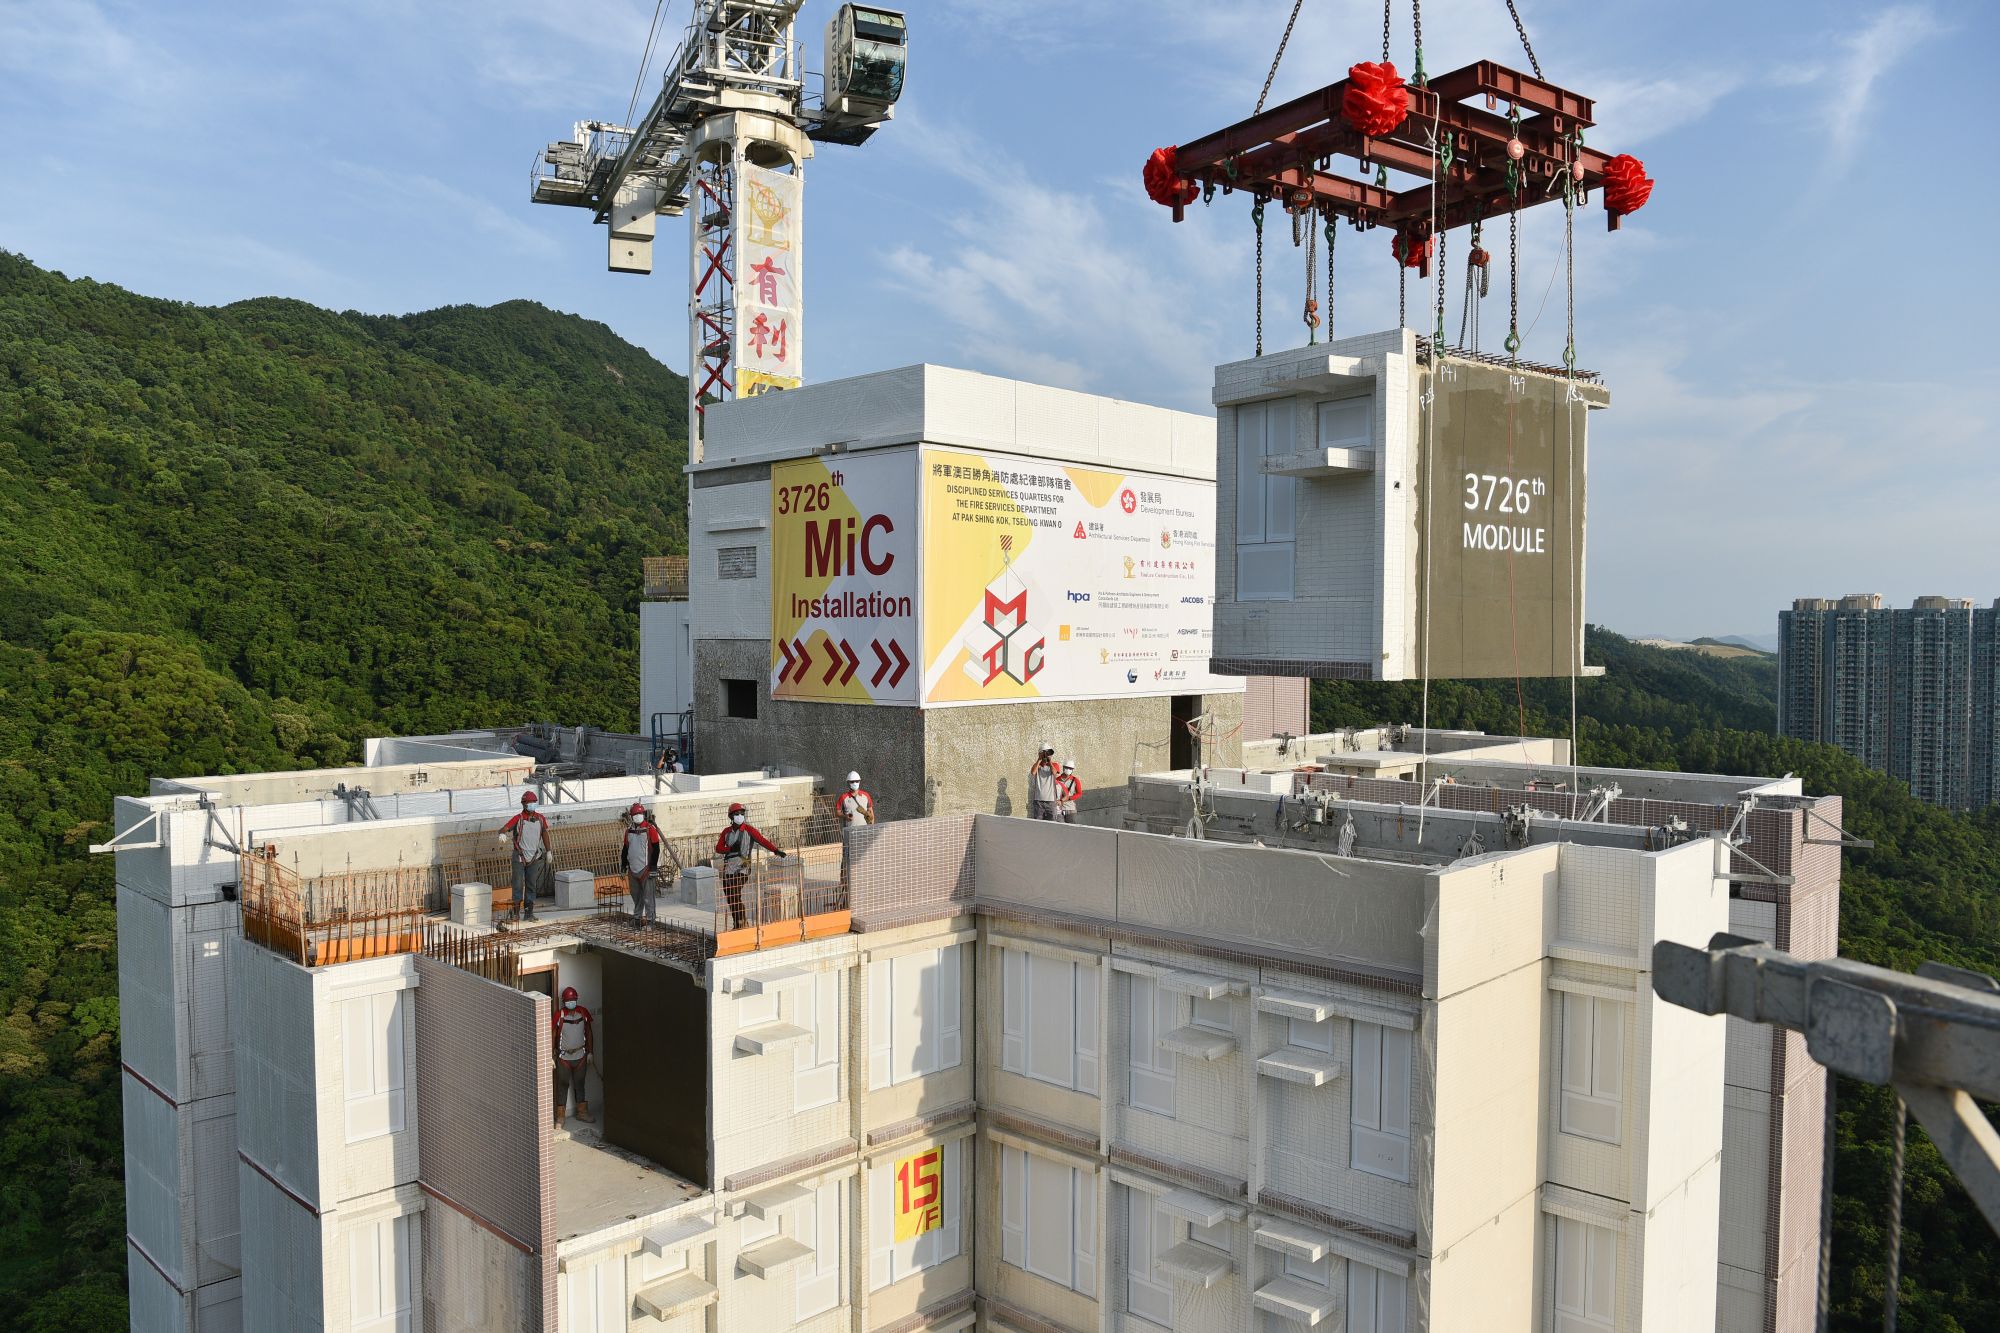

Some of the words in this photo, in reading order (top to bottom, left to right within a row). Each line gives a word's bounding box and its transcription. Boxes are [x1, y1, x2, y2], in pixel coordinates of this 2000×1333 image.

[748, 256, 787, 363] 有利
[932, 463, 1072, 491] 將軍澳百勝角消防處紀律部隊宿舍
[946, 484, 988, 497] DISCIPLINED
[988, 488, 1019, 500] SERVICES
[1020, 491, 1052, 503] QUARTERS
[1052, 494, 1065, 504] FOR
[1140, 491, 1162, 504] 發展局
[956, 499, 969, 509] THE
[969, 500, 984, 510] FIRE
[985, 501, 1015, 513] SERVICES
[1016, 504, 1057, 516] DEPARTMENT
[1141, 504, 1175, 516] Development
[1175, 508, 1195, 518] Bureau
[952, 512, 961, 521] AT
[961, 513, 974, 522] PAK
[975, 515, 995, 524] SHING
[996, 516, 1011, 526] KOK,
[1012, 517, 1039, 527] TSEUNG
[1039, 519, 1057, 529] KWAN
[1057, 520, 1063, 529] O
[804, 514, 895, 578] MiC
[1463, 522, 1546, 553] MODULE
[792, 591, 912, 619] Installation
[1067, 590, 1090, 603] hpa
[1180, 596, 1204, 604] JACOBS
[898, 1151, 939, 1214] 15
